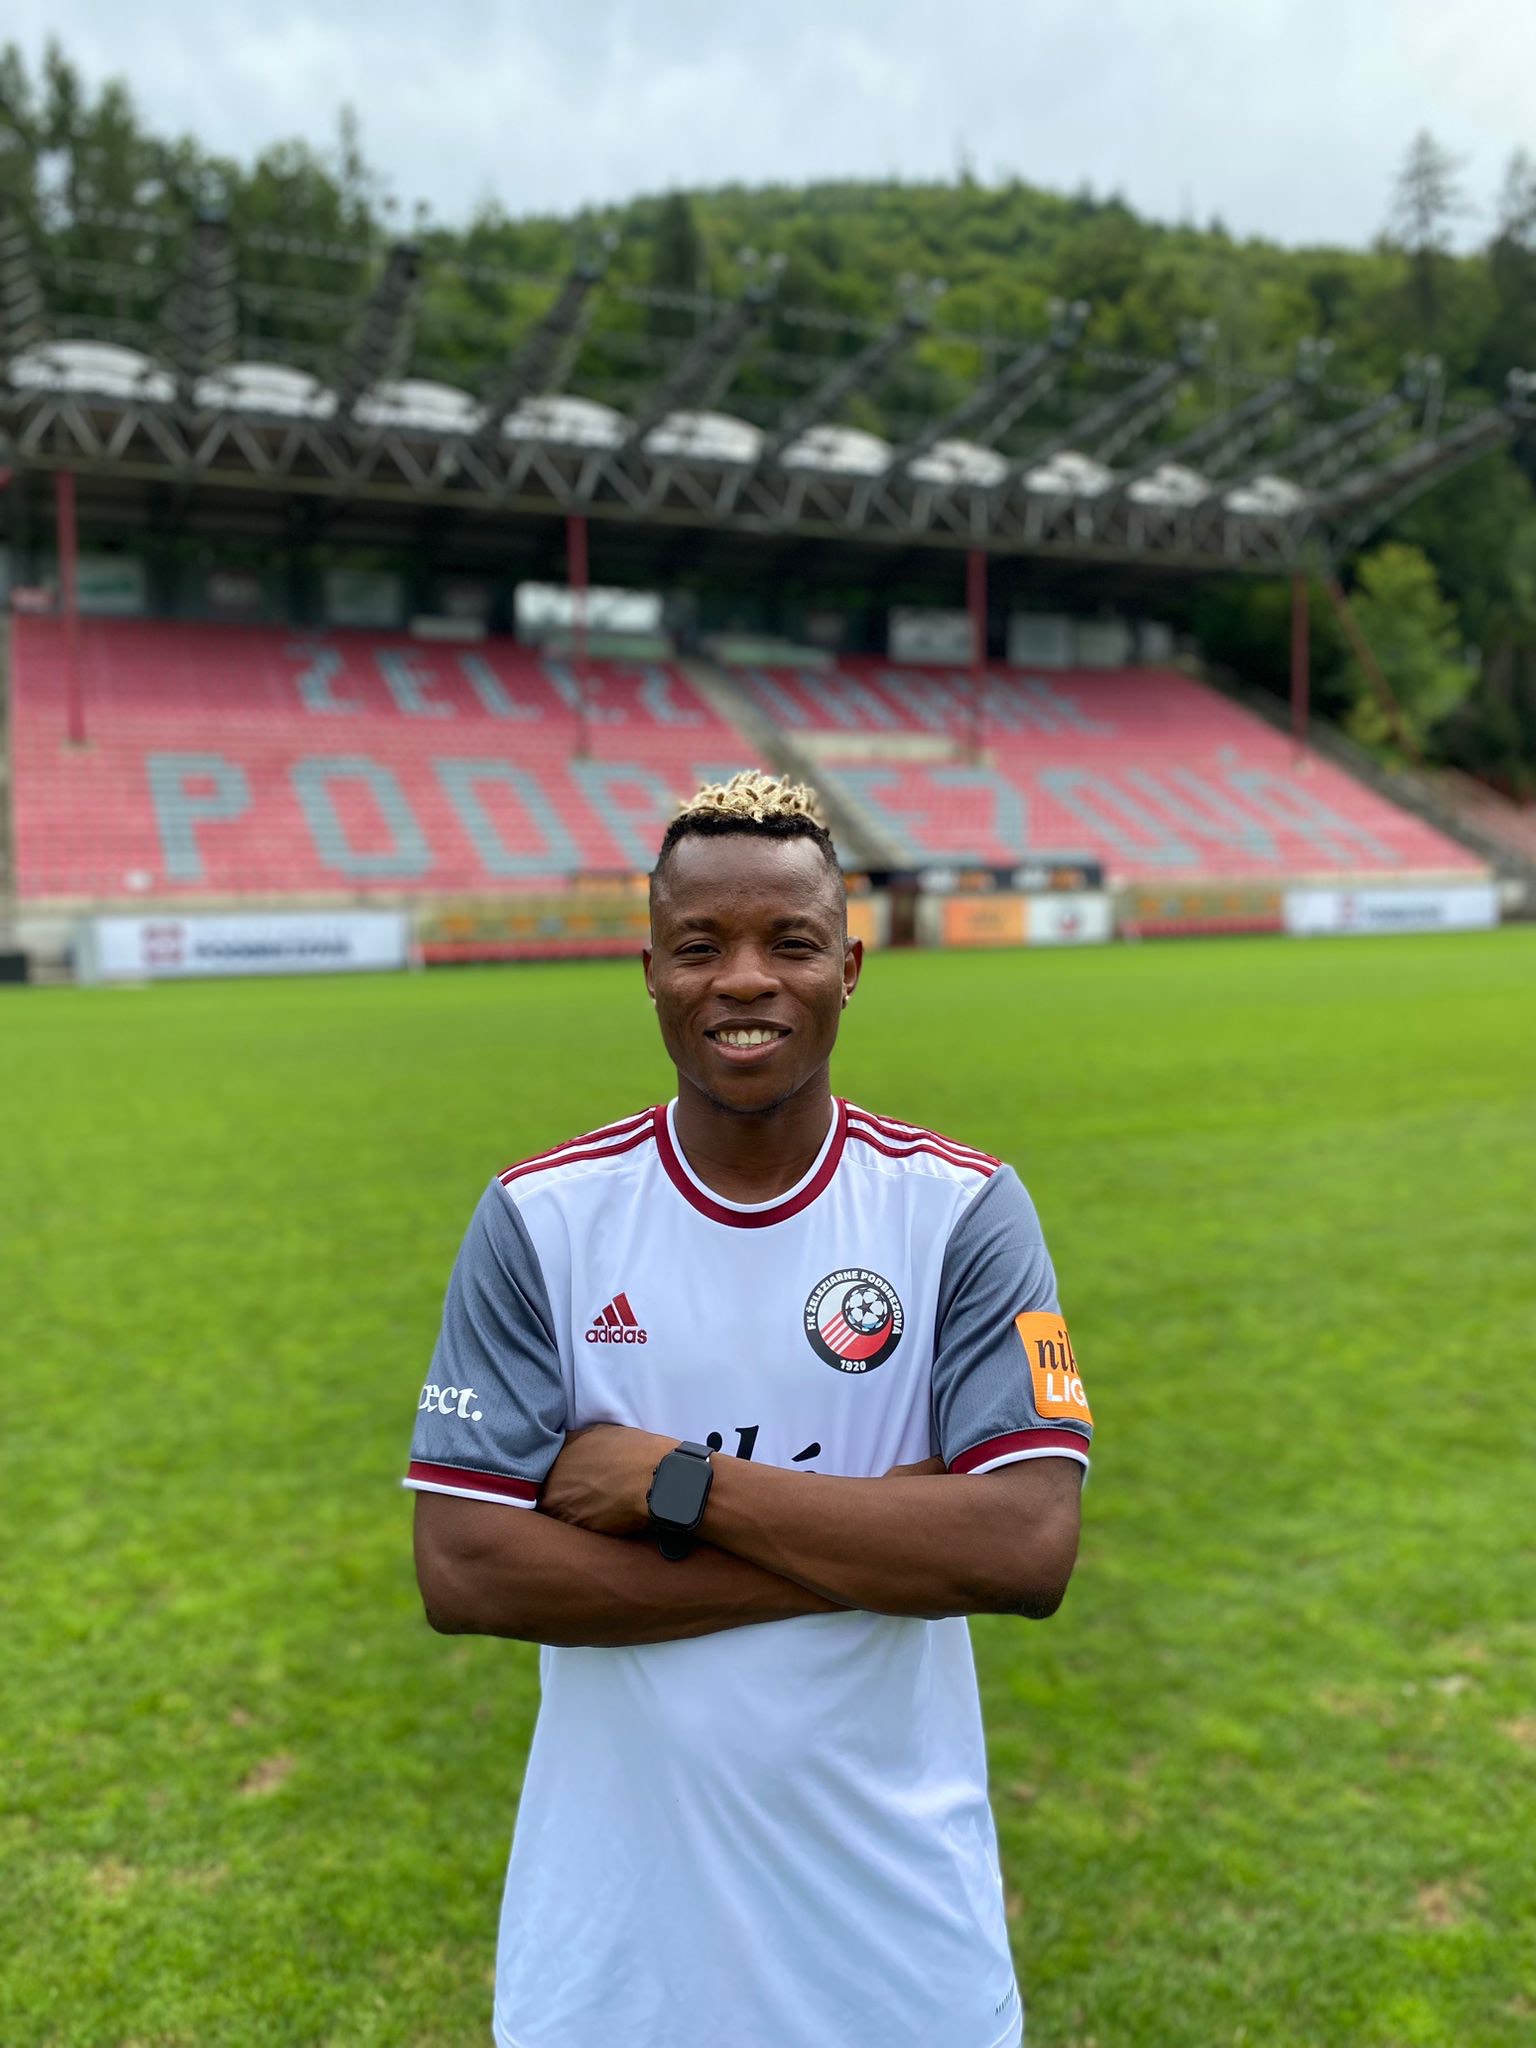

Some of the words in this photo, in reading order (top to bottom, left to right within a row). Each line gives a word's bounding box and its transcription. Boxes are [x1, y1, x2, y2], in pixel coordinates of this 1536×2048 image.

[806, 1270, 859, 1315] ŽELEZIARNE
[806, 1315, 817, 1331] FK
[585, 1325, 648, 1345] adidas
[840, 1359, 867, 1371] 1920
